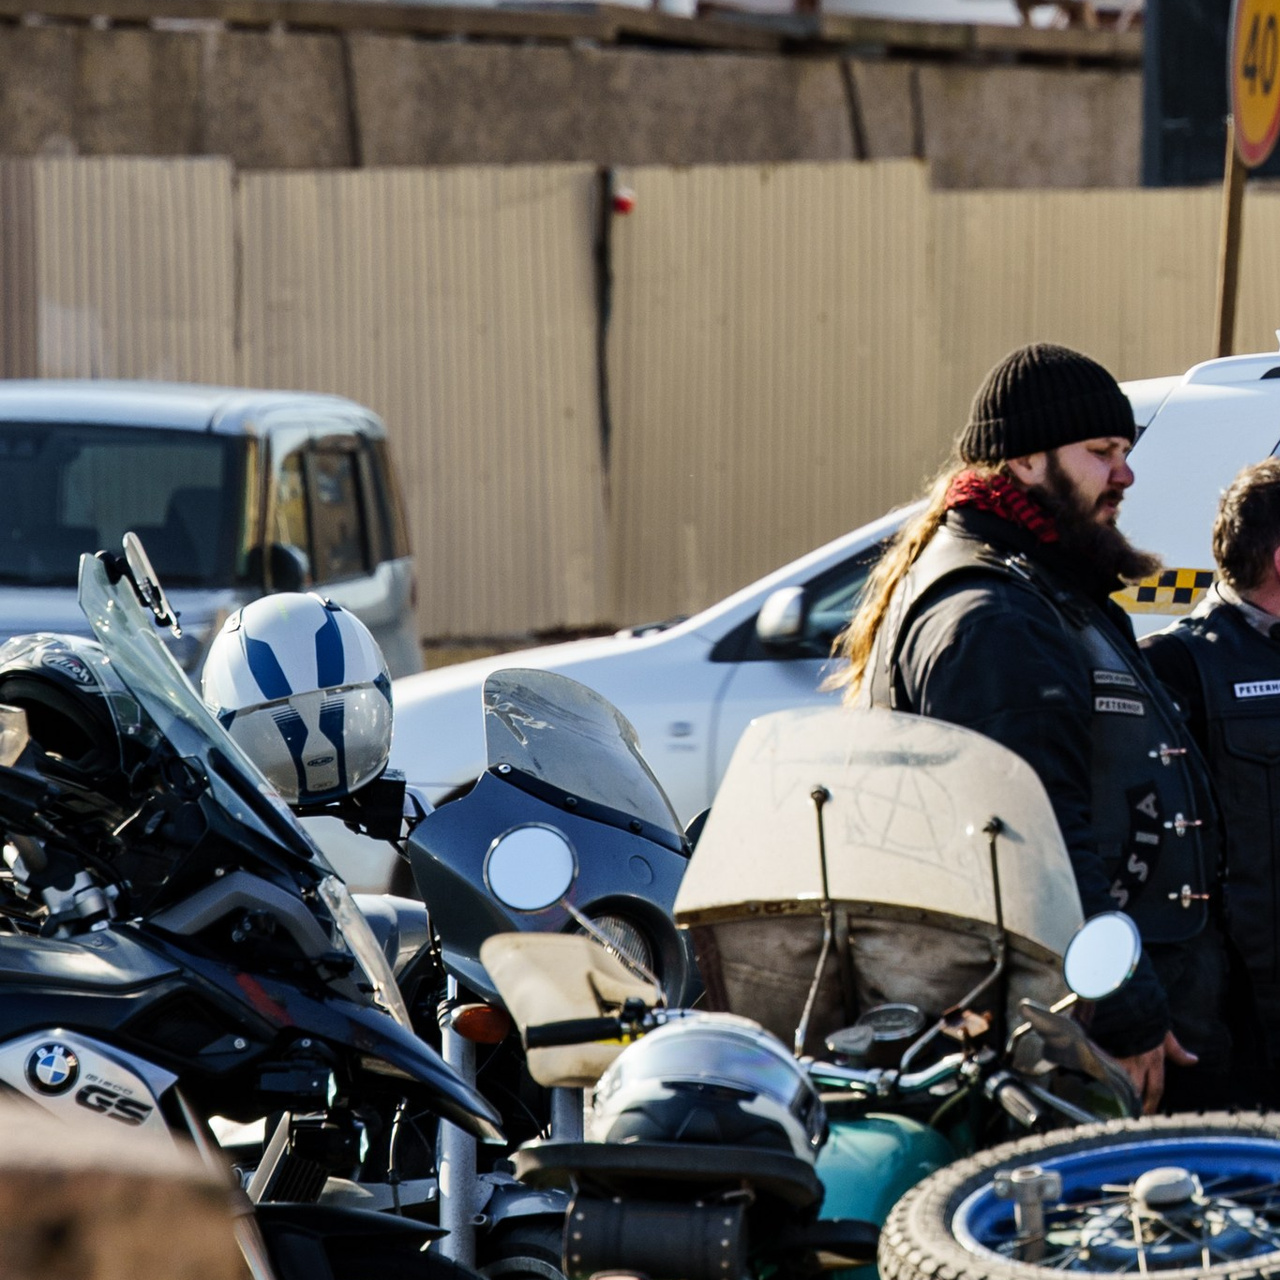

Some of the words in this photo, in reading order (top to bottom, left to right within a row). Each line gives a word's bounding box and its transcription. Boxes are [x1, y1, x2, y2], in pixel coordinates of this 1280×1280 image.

[1242, 12, 1279, 96] 40
[36, 1045, 78, 1067] BMW
[75, 1084, 153, 1127] GS
